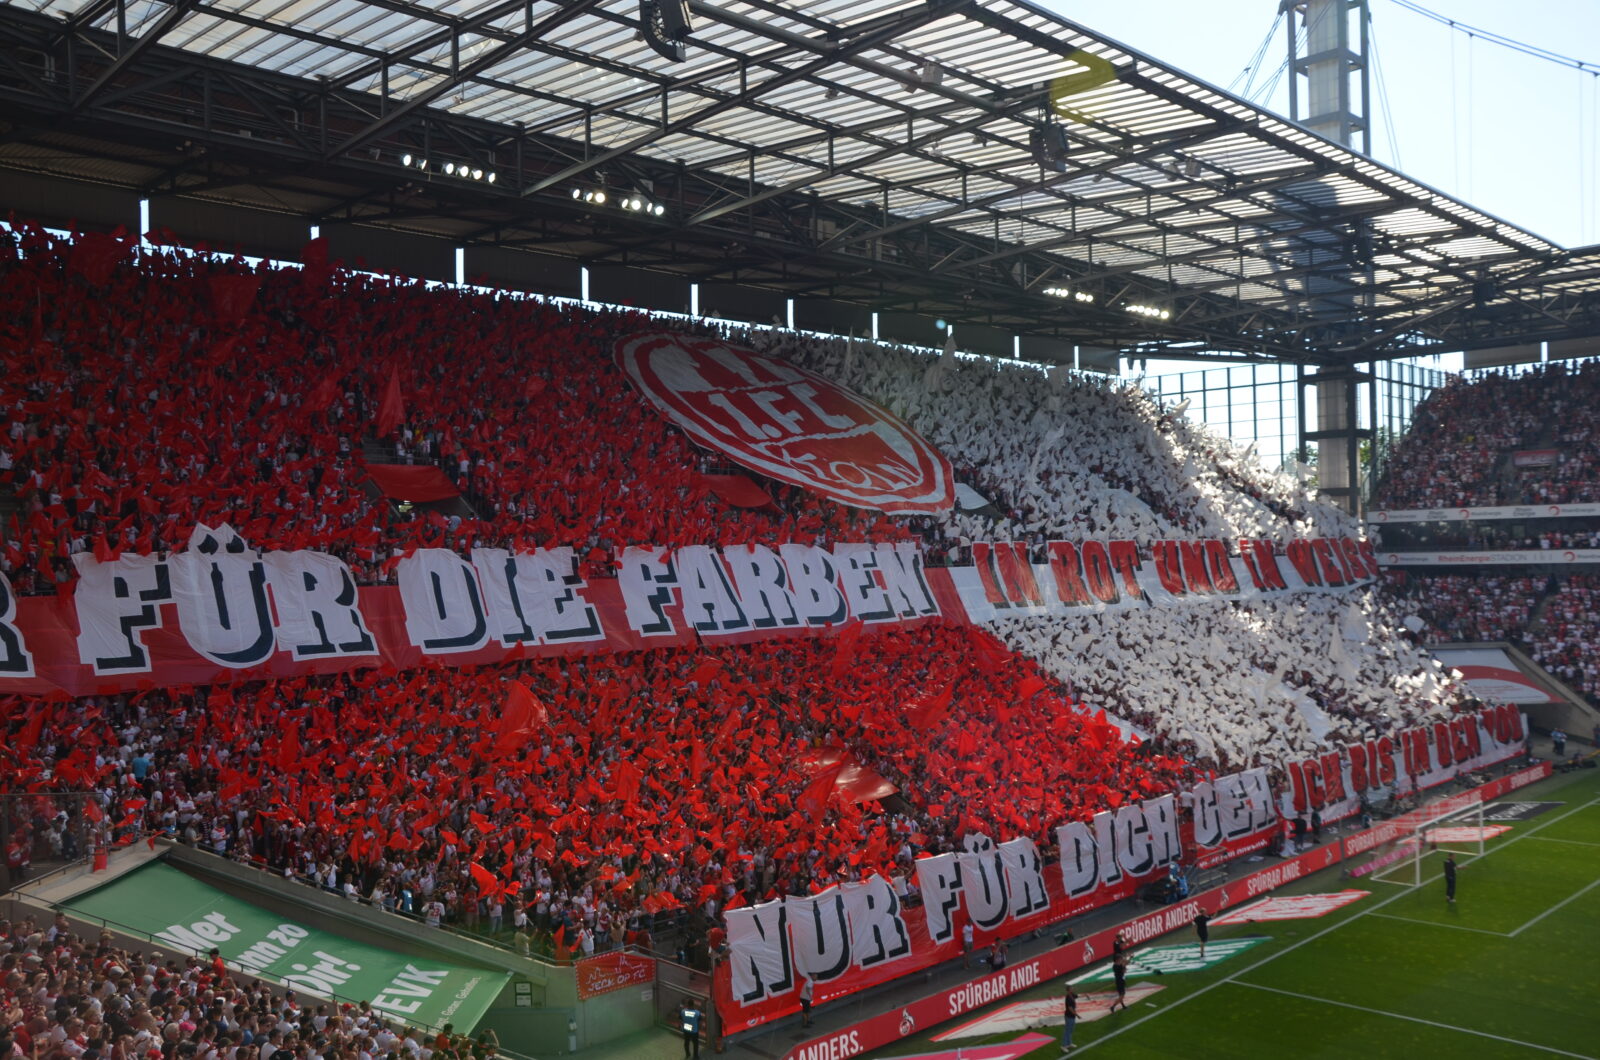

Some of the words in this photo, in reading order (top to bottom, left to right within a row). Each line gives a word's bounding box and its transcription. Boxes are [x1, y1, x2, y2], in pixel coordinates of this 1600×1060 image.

[72, 521, 380, 676] FÜR
[396, 546, 606, 656] DIE
[613, 542, 942, 637] FARBEN
[971, 540, 1046, 609] IN
[1047, 540, 1152, 608] ROT
[1152, 539, 1241, 596] UND
[1286, 536, 1379, 588] WEISS
[723, 873, 911, 1007] NUR
[915, 832, 1050, 944] FÜR
[1056, 793, 1182, 898] DICH
[1194, 767, 1277, 848] GEH
[1288, 751, 1348, 813] ICH
[1348, 736, 1397, 795] BIS
[1402, 727, 1433, 776] IN
[1433, 714, 1483, 770] DEN
[1247, 869, 1282, 897] SPÜRBAR
[154, 911, 242, 958] Mer
[266, 923, 309, 947] zo
[280, 950, 361, 997] Dir!
[948, 974, 1007, 1016] SPÜRBAR
[798, 1029, 864, 1060] ANDERS.
